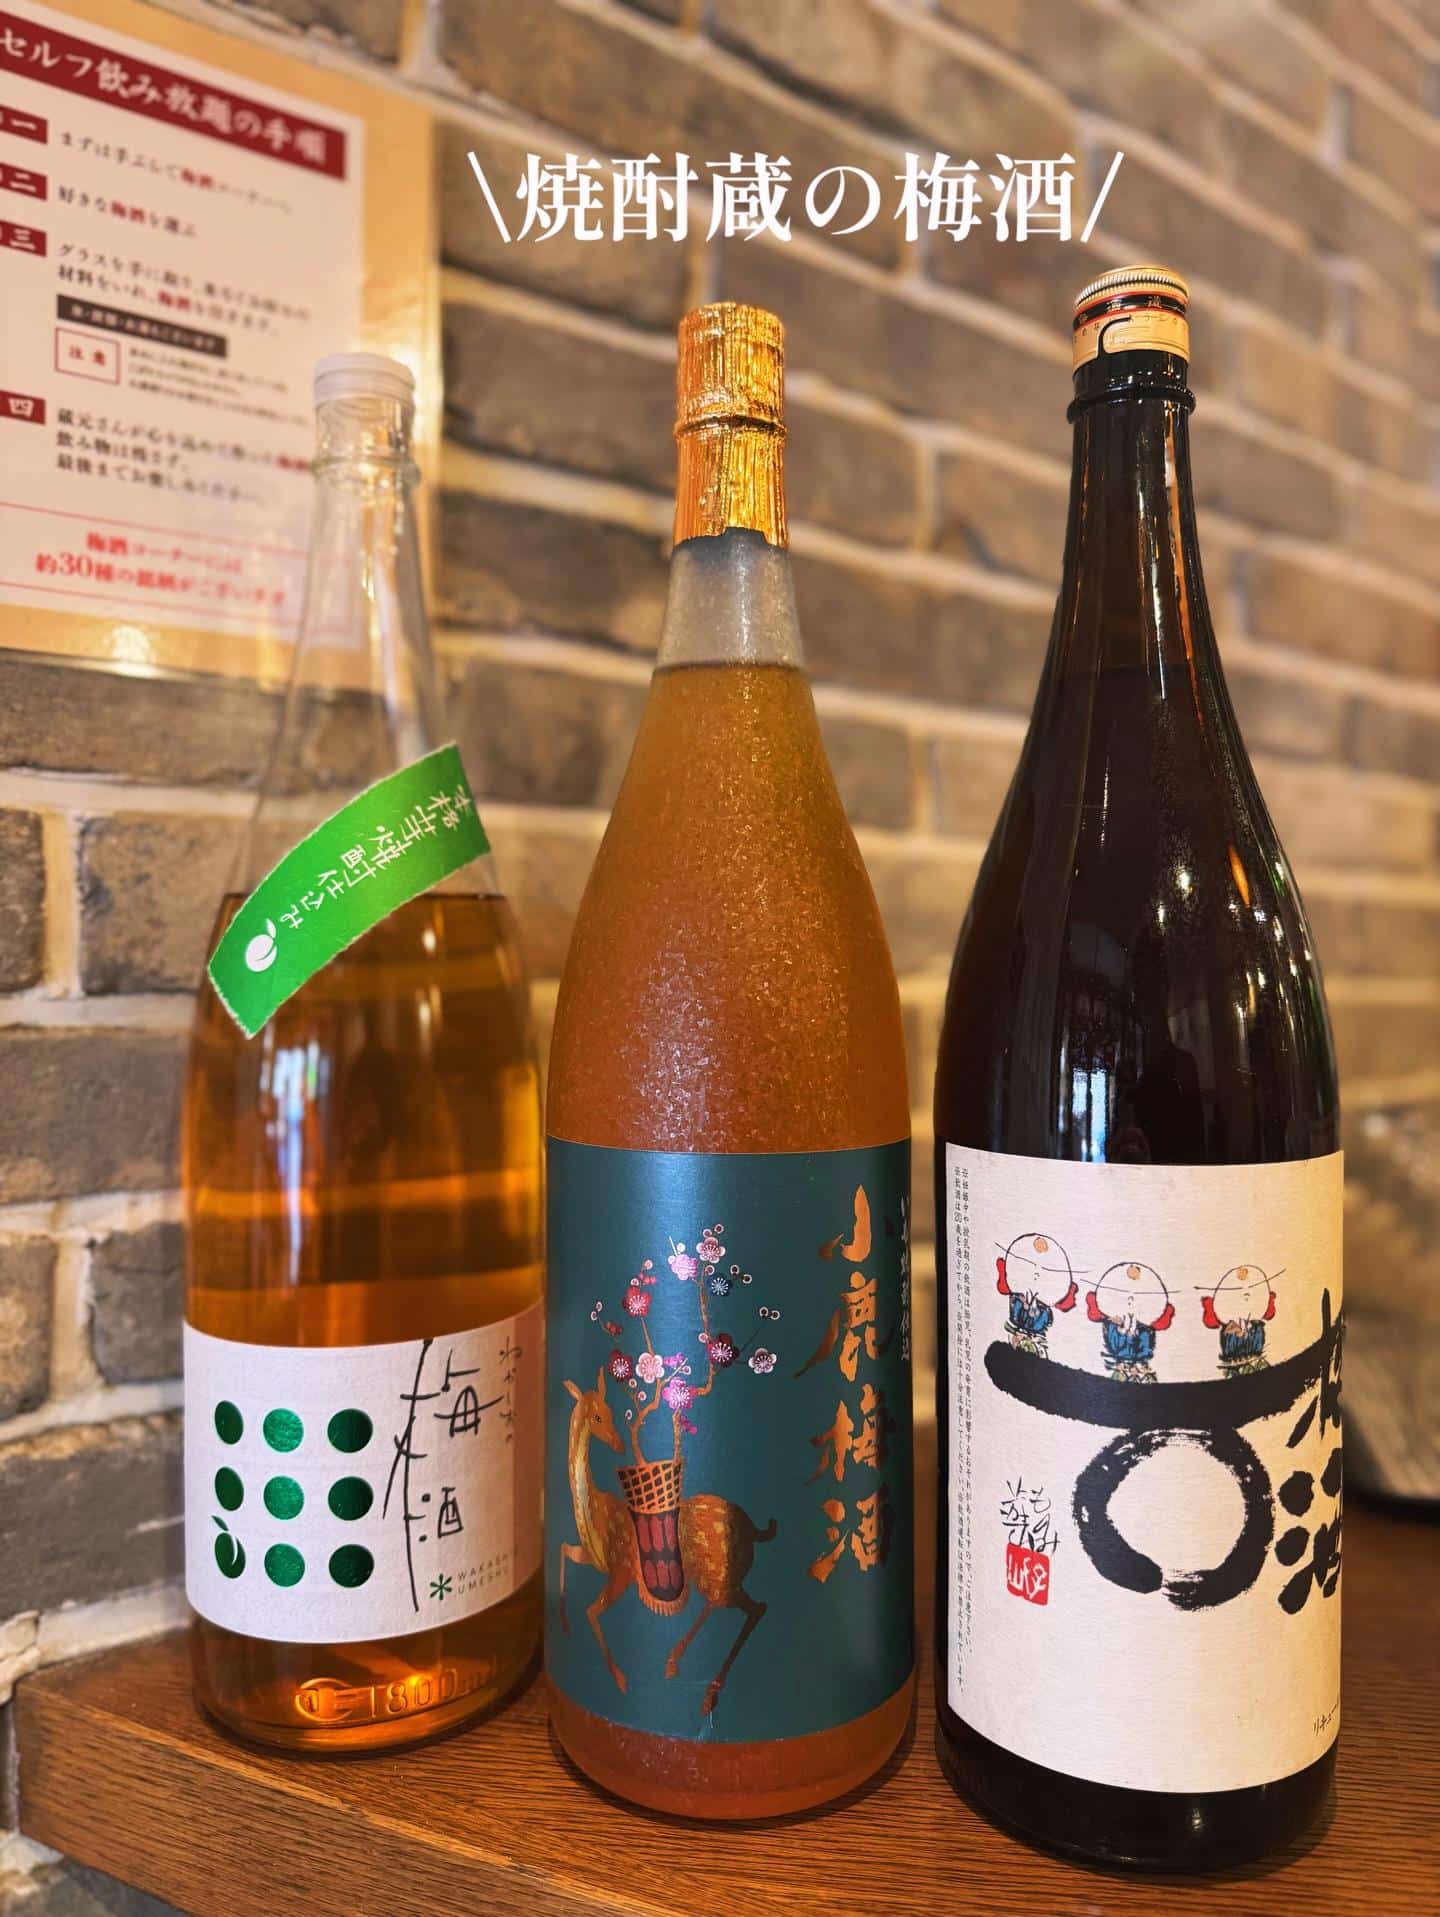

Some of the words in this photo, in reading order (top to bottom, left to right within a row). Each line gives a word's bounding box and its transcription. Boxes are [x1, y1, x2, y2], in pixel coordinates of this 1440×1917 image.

[279, 783, 471, 929] 本格芋焼酎仕込み
[793, 1184, 889, 1584] 小鹿梅酒
